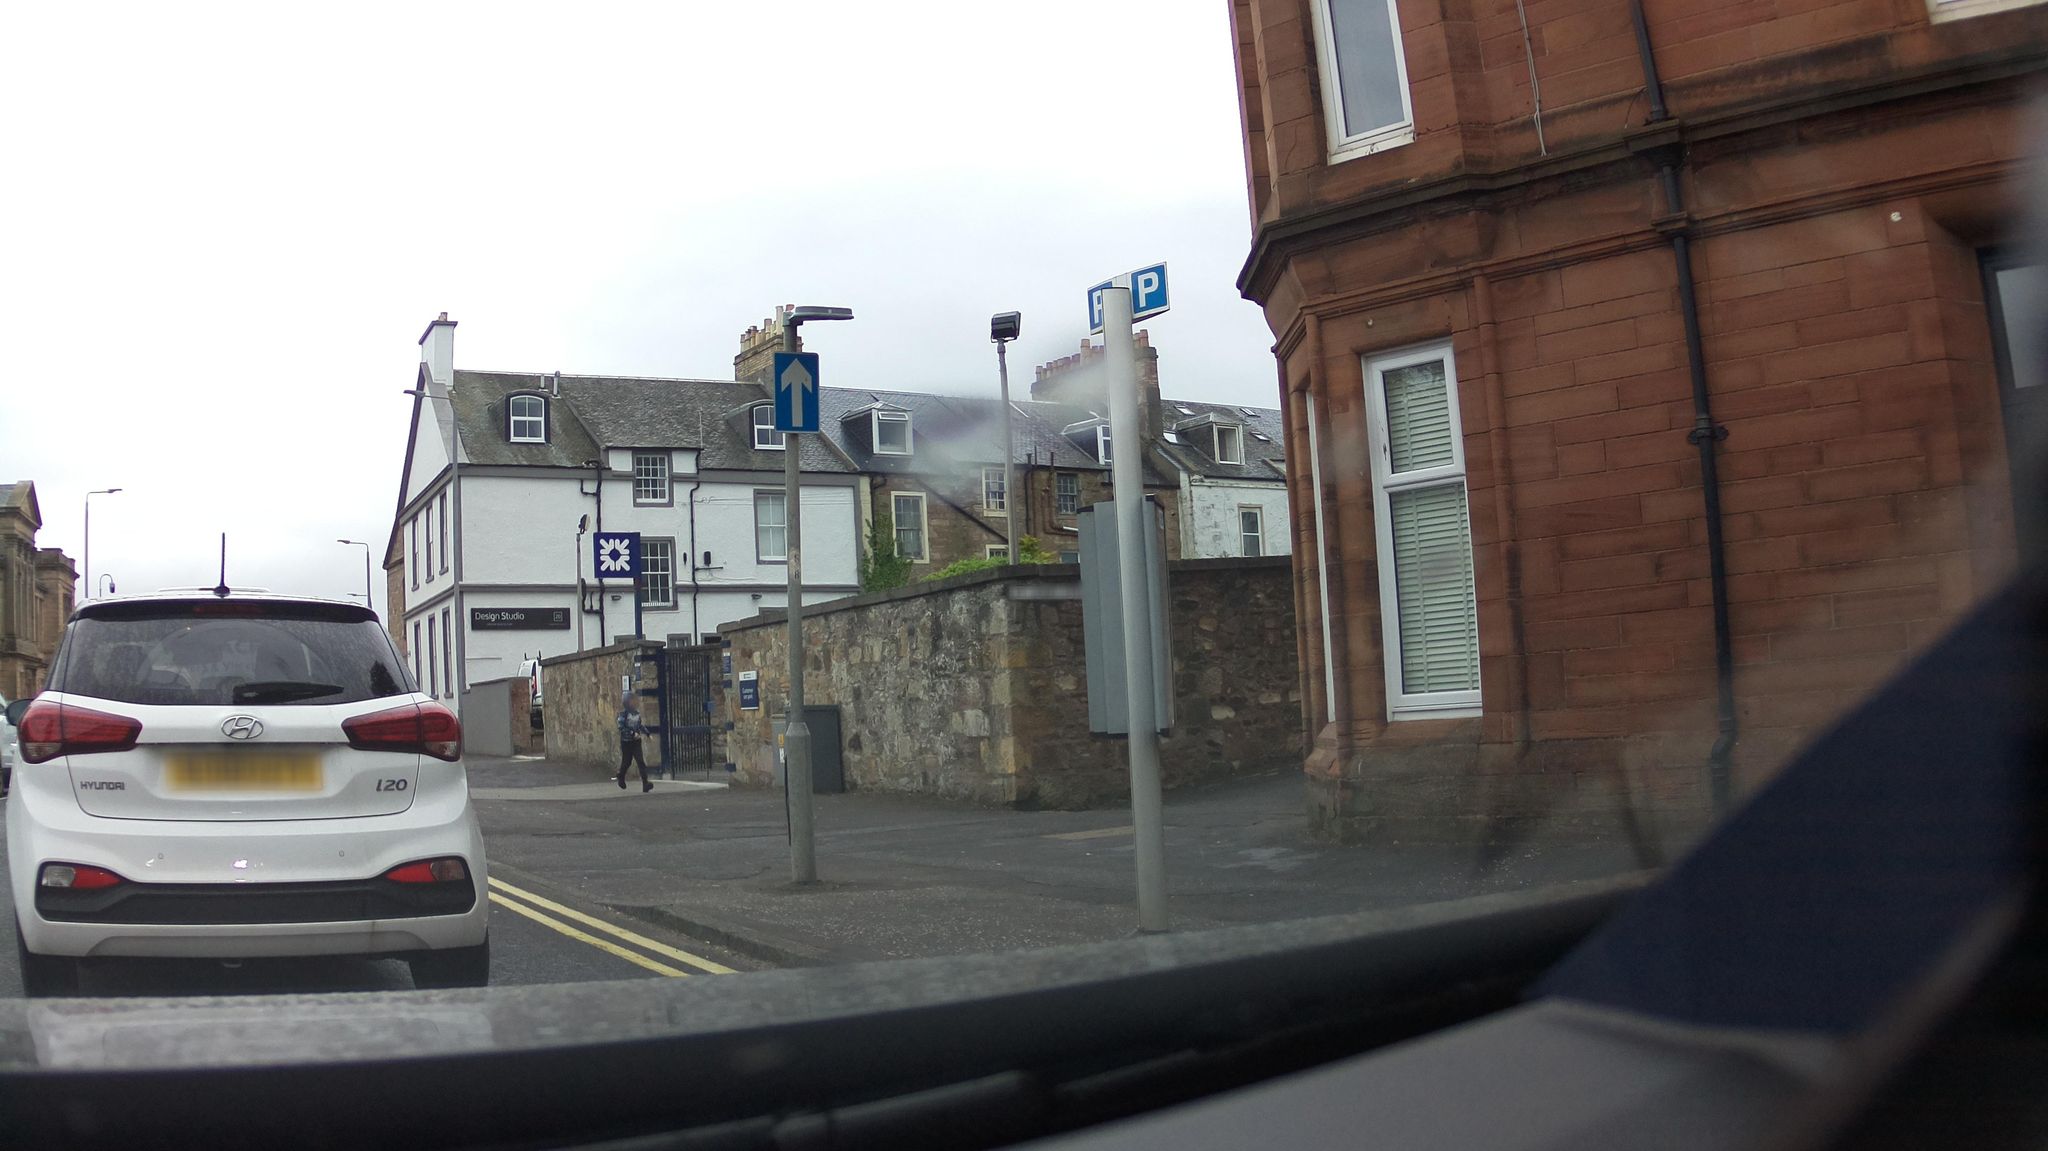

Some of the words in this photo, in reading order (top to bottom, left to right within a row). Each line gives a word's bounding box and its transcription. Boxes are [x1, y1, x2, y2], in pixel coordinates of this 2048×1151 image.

[1137, 271, 1159, 308] P
[474, 611, 500, 622] Design
[501, 611, 525, 621] Studio
[80, 781, 125, 791] HYUNDAI
